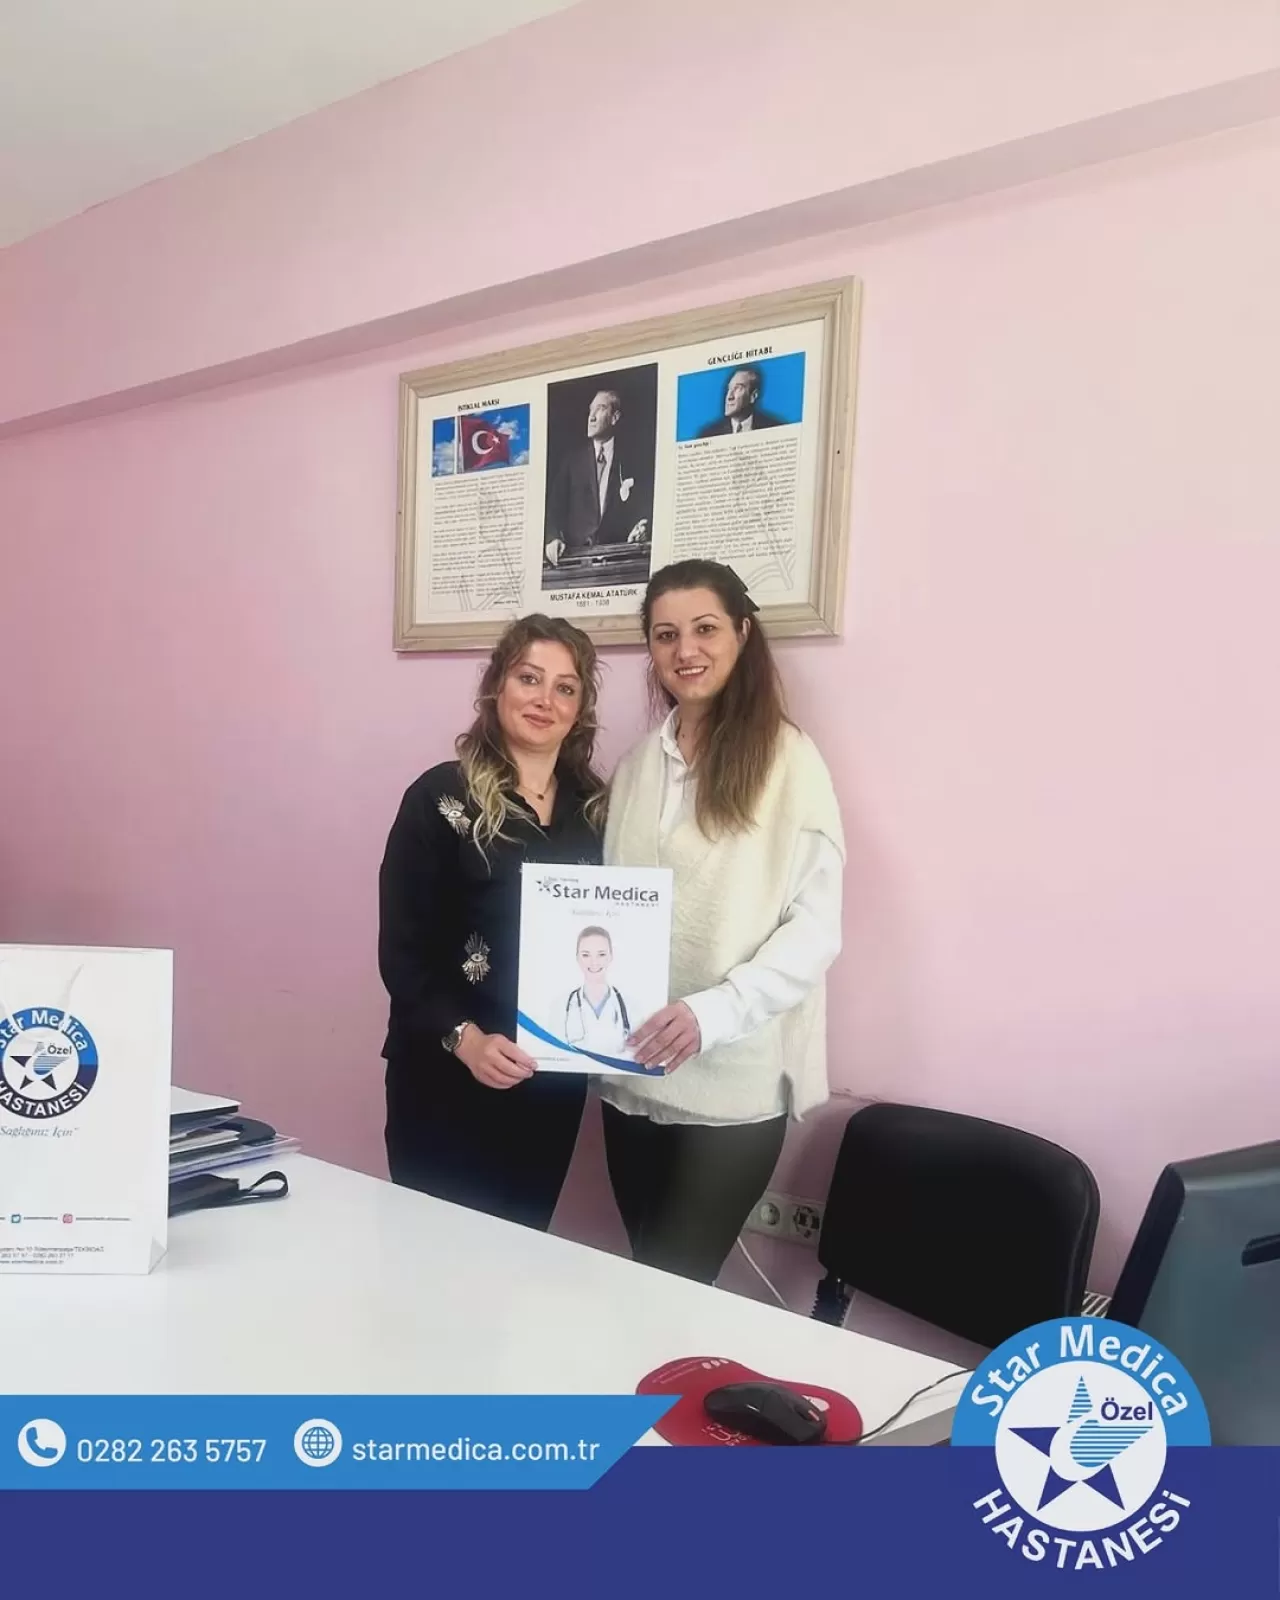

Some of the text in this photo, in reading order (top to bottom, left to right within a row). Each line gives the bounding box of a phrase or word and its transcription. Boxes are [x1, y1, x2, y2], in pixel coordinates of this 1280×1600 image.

[550, 586, 638, 601] MUSTAFA KEMAL ATATÜRK
[552, 883, 659, 902] Star Medica
[47, 1042, 72, 1055] Özel
